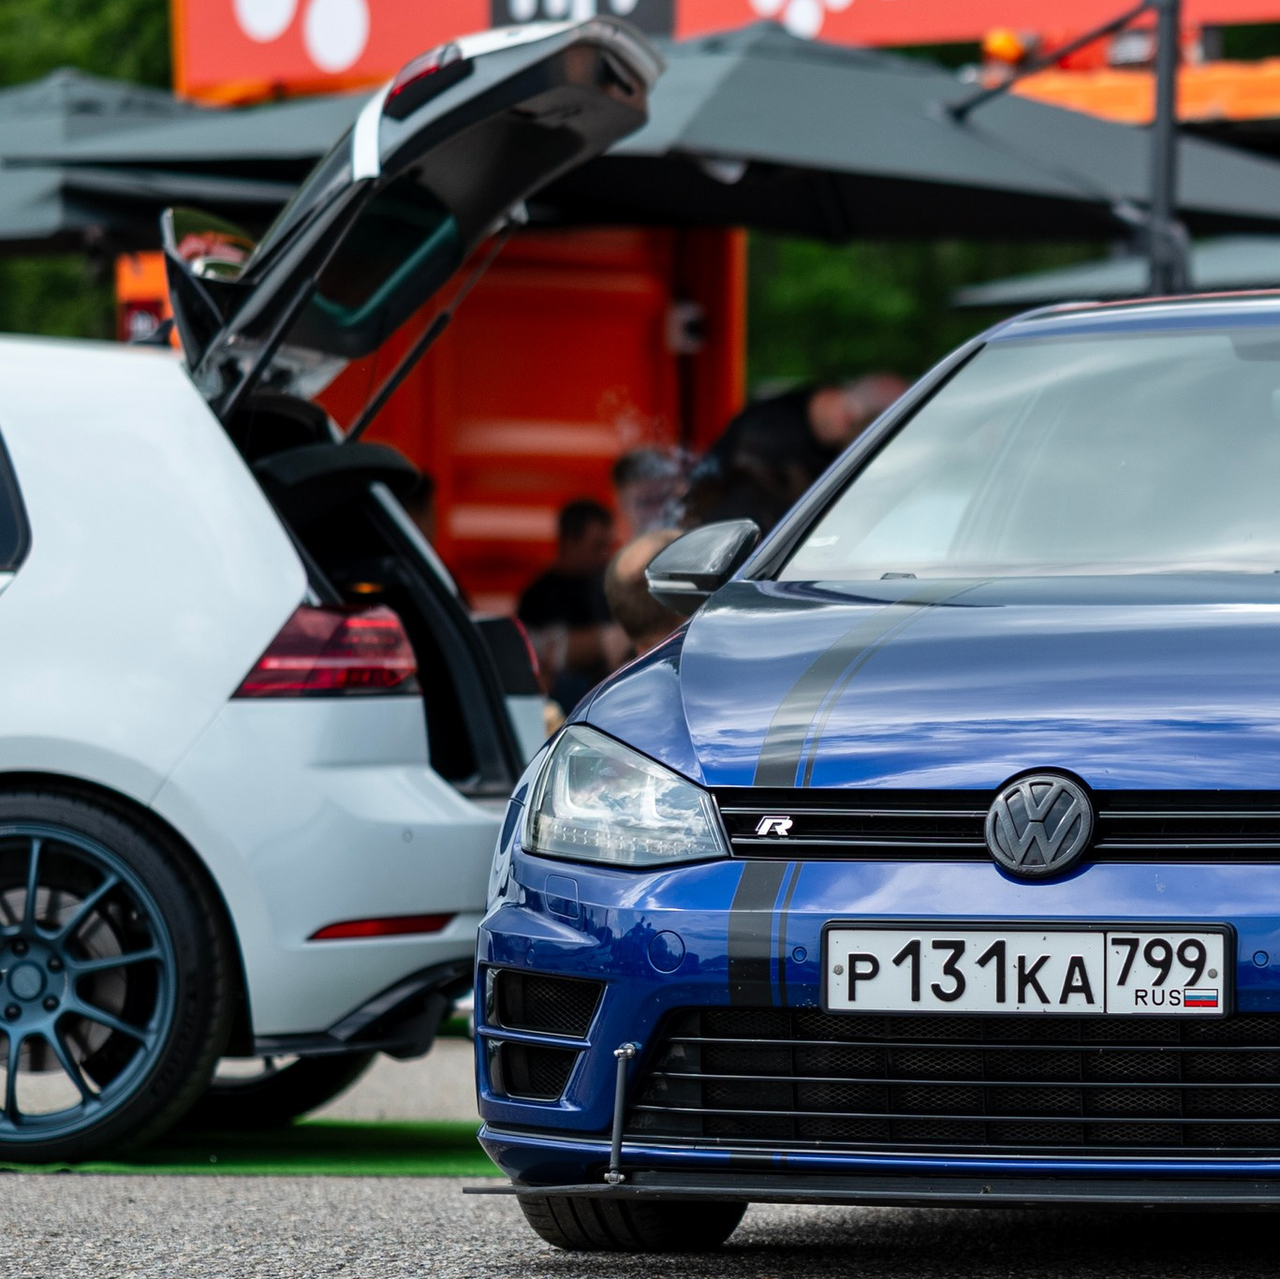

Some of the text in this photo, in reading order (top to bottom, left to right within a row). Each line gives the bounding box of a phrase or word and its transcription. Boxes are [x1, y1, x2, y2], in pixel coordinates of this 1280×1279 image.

[756, 815, 793, 836] R
[1110, 937, 1207, 987] 799
[1134, 989, 1182, 1007] RUS
